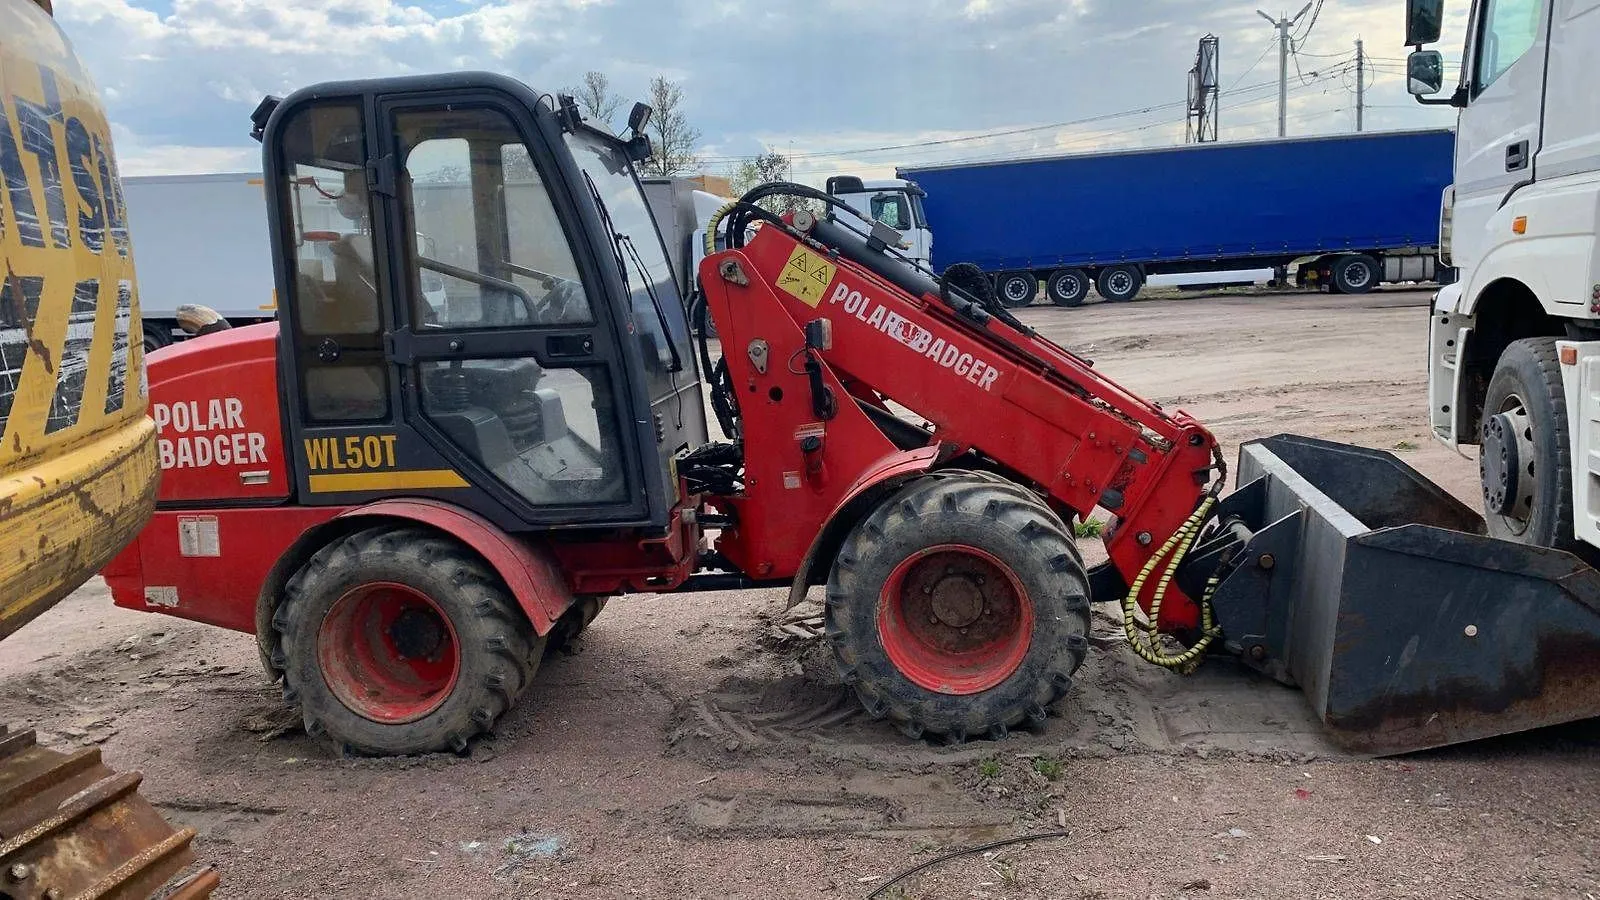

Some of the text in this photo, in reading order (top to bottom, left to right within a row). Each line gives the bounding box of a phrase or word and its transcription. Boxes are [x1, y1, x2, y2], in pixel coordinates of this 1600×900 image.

[829, 282, 999, 392] POLAR BADGER
[153, 397, 245, 434] POLAR
[158, 432, 268, 470] BADGER
[303, 435, 397, 470] WL50T
